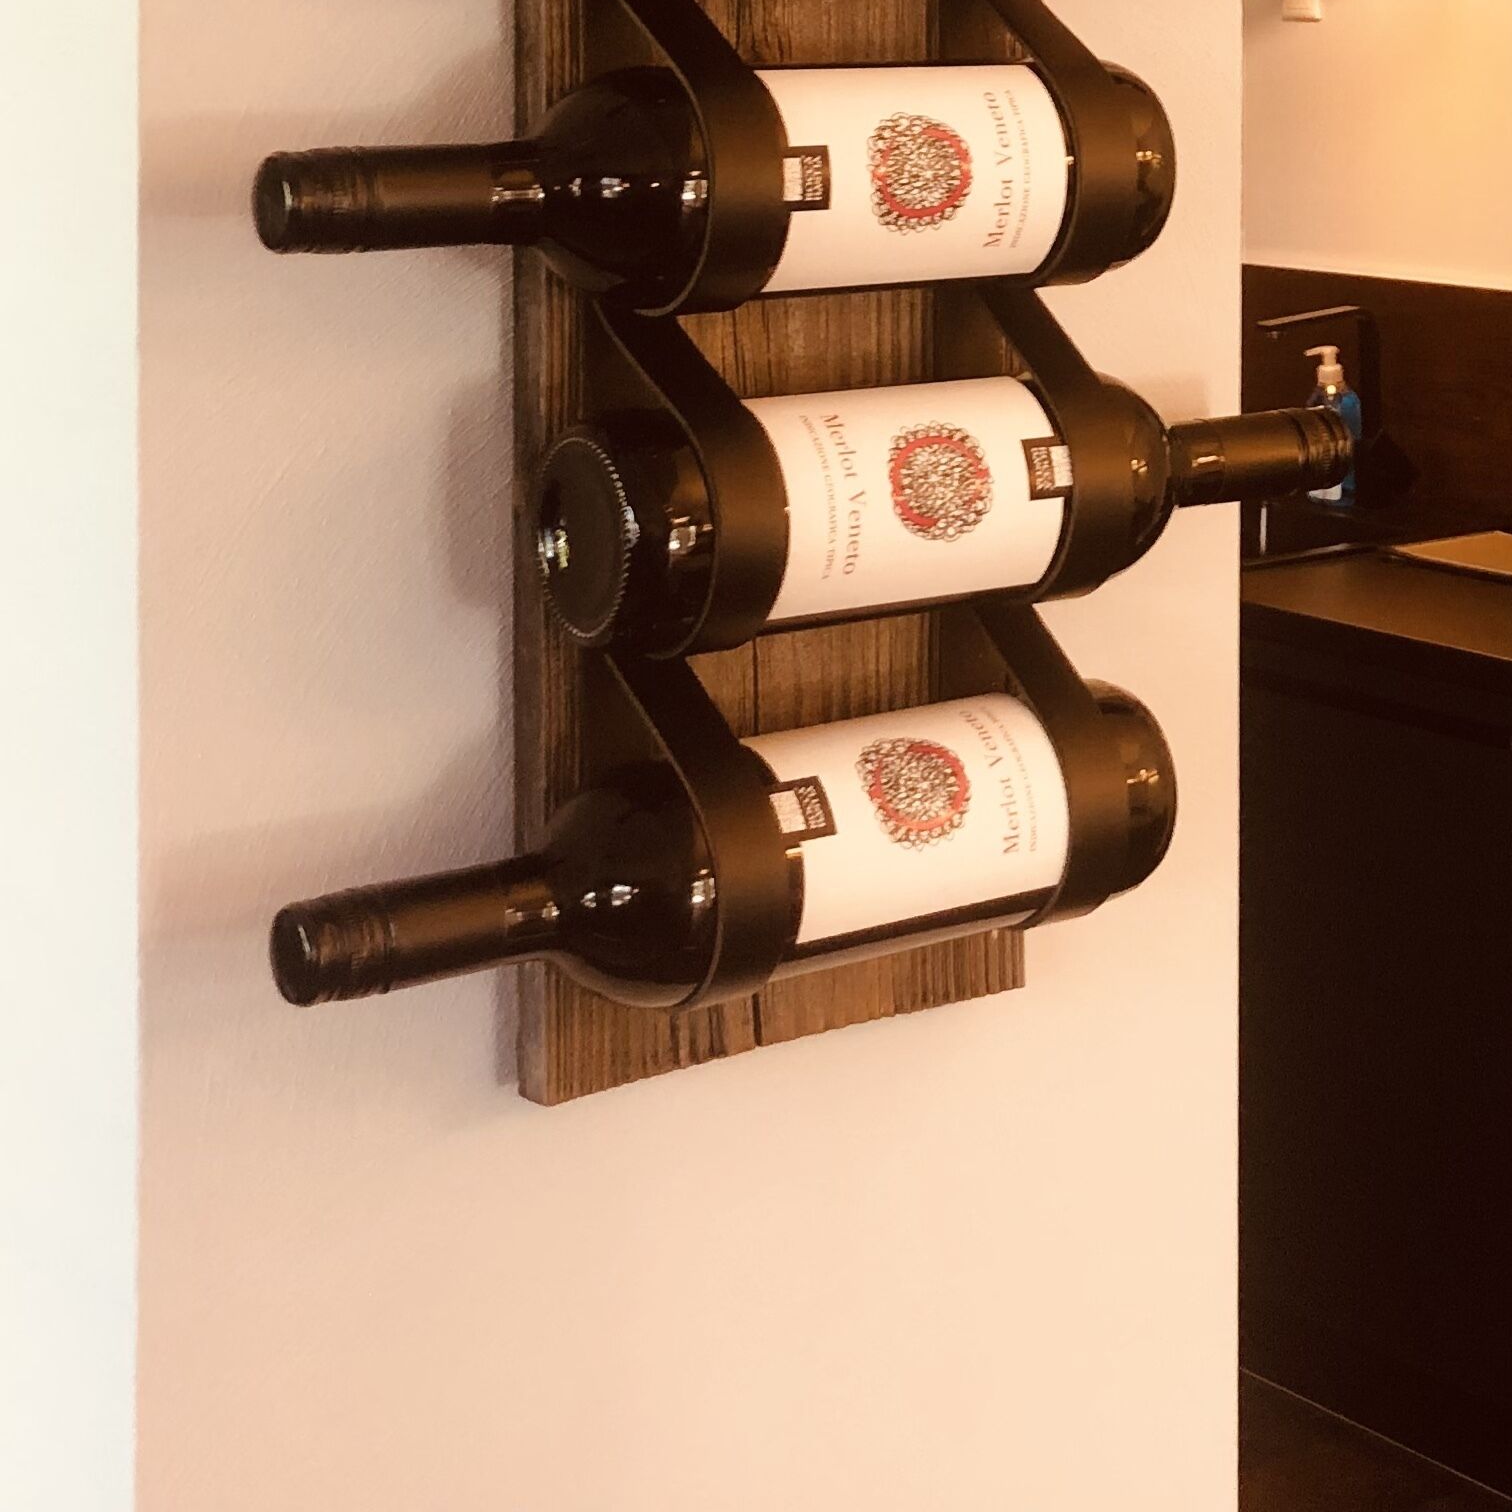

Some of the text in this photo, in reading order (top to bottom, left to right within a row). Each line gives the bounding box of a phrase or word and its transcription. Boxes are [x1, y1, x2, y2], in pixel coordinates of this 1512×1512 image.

[982, 92, 1014, 248] Merlot Veneto
[820, 414, 868, 576] Merlot Veneto
[959, 711, 1004, 768] Veneto
[998, 776, 1021, 855] Merlot
